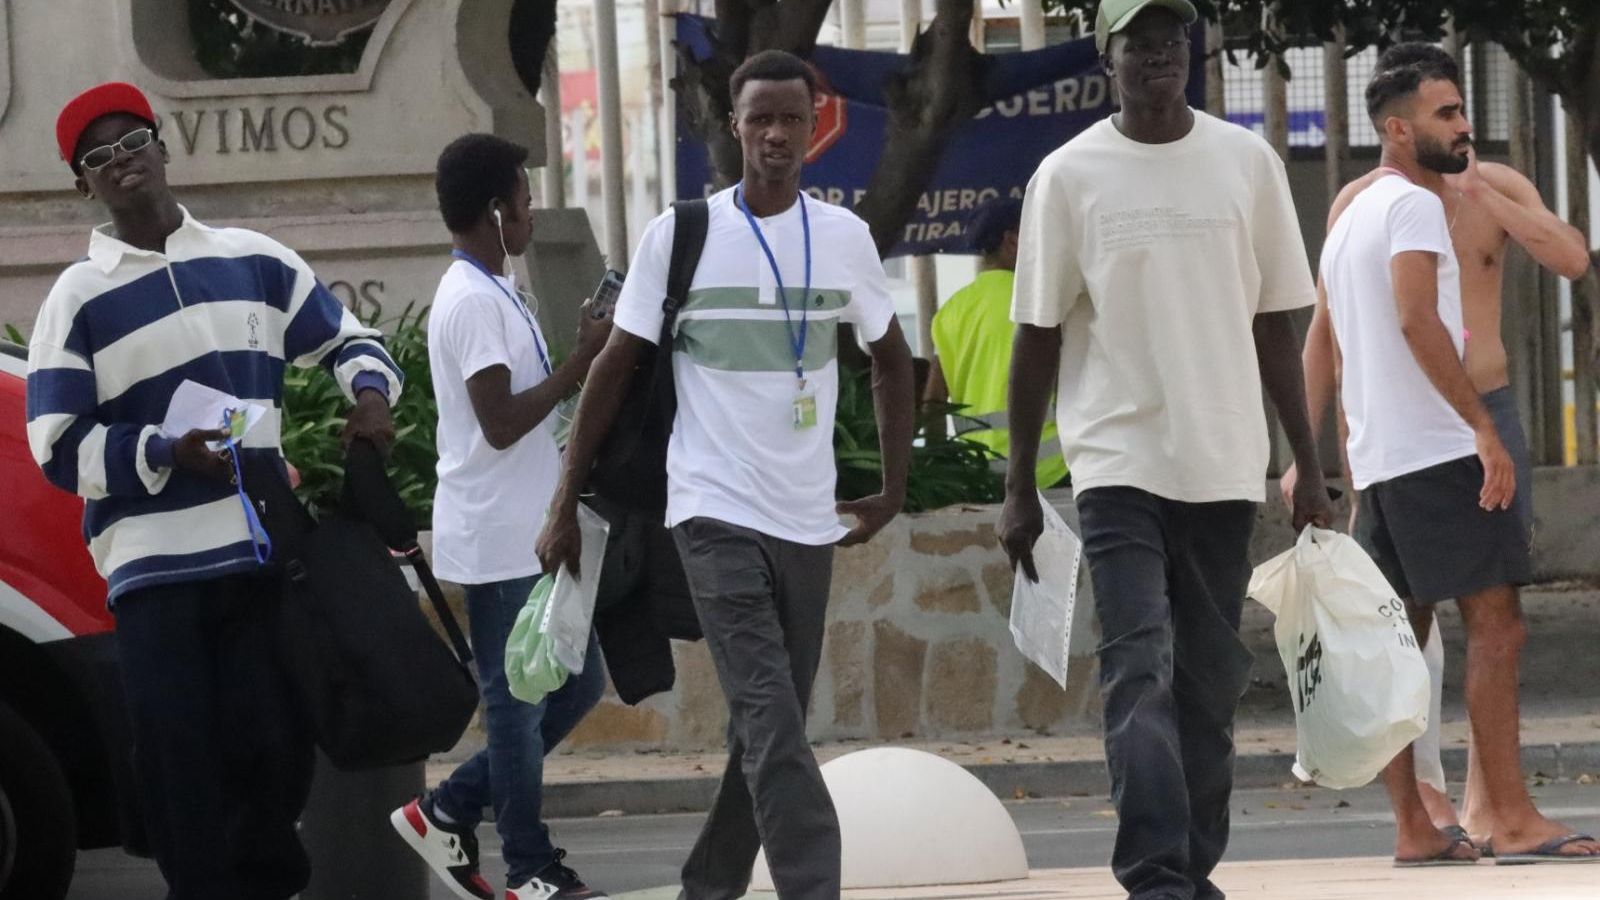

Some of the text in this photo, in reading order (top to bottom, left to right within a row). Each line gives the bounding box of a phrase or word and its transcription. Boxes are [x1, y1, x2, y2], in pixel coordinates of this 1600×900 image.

[973, 74, 1121, 119] UERD
[156, 105, 349, 156] VIMOS
[903, 220, 968, 241] TIRA
